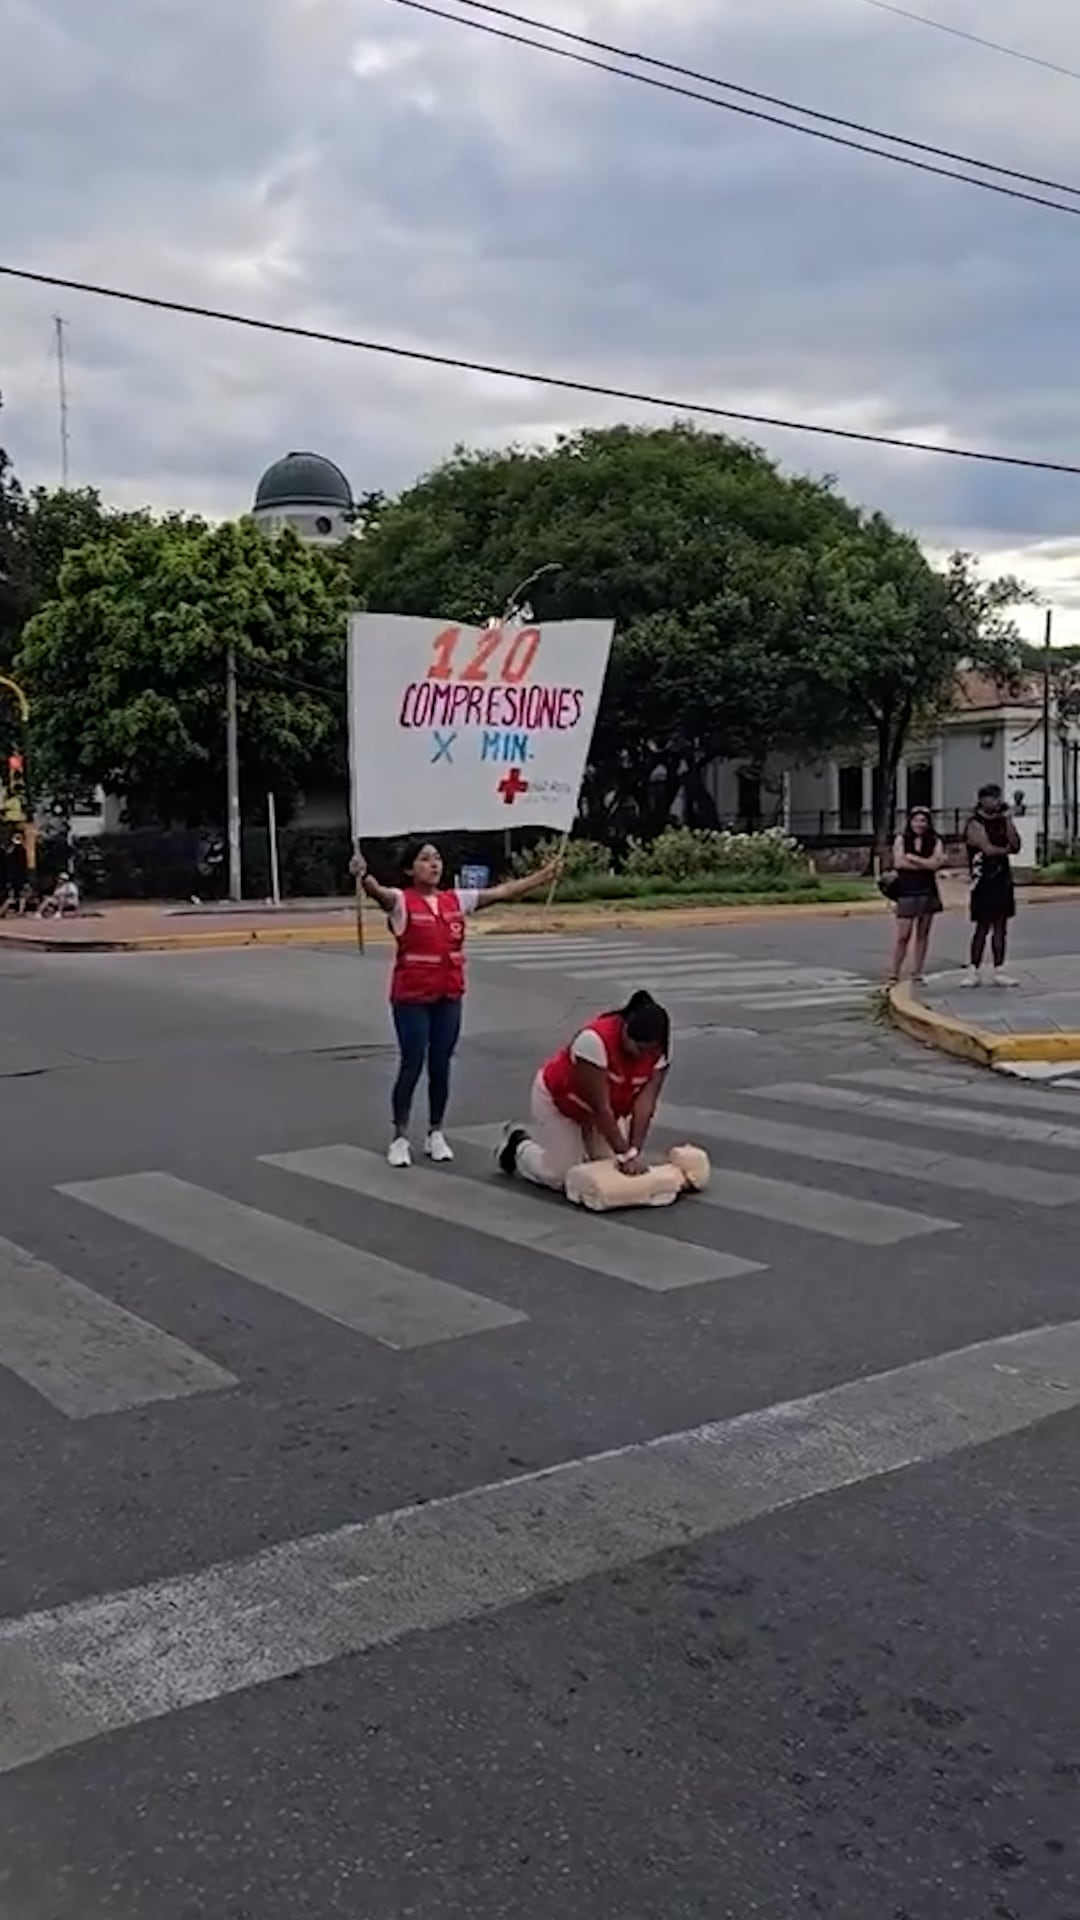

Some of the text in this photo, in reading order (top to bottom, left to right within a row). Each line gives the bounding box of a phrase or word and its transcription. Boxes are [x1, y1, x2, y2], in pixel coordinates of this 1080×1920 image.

[427, 627, 541, 682] 120
[400, 683, 583, 729] COMPRESIONES
[431, 731, 535, 763] X MIN.
